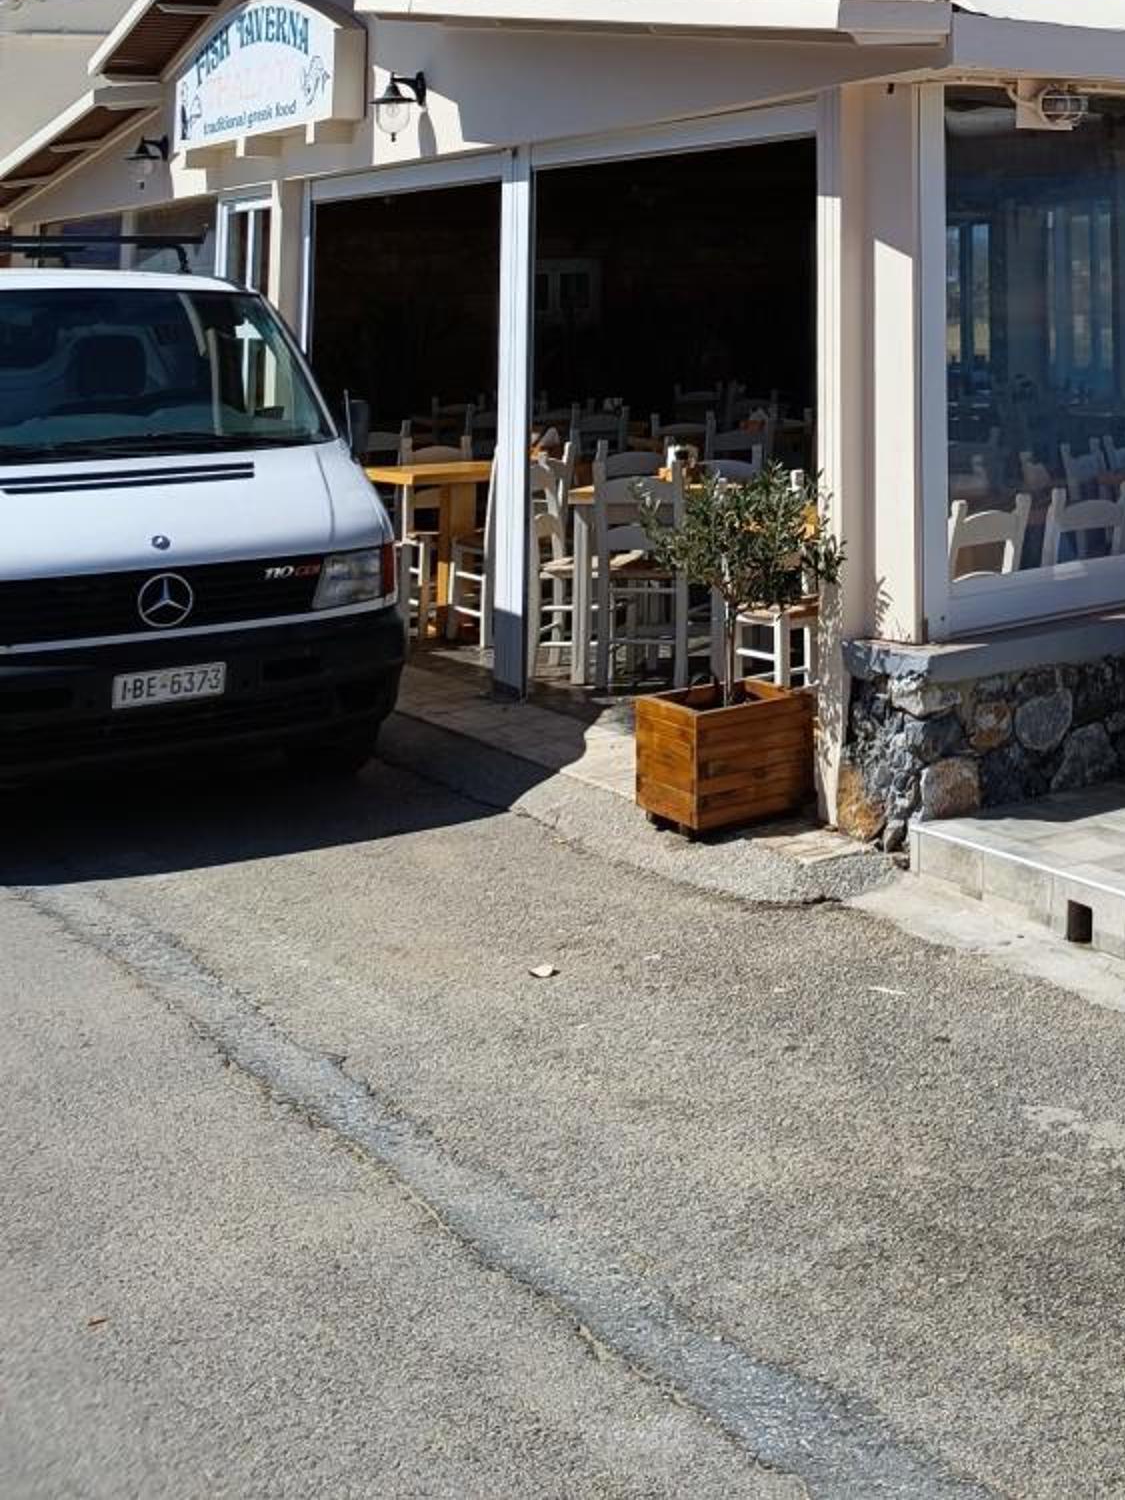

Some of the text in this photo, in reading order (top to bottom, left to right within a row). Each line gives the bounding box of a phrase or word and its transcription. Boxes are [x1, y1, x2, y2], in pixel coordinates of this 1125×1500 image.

[194, 25, 231, 86] FISH
[236, 5, 310, 56] TAVERNA
[275, 100, 297, 117] food
